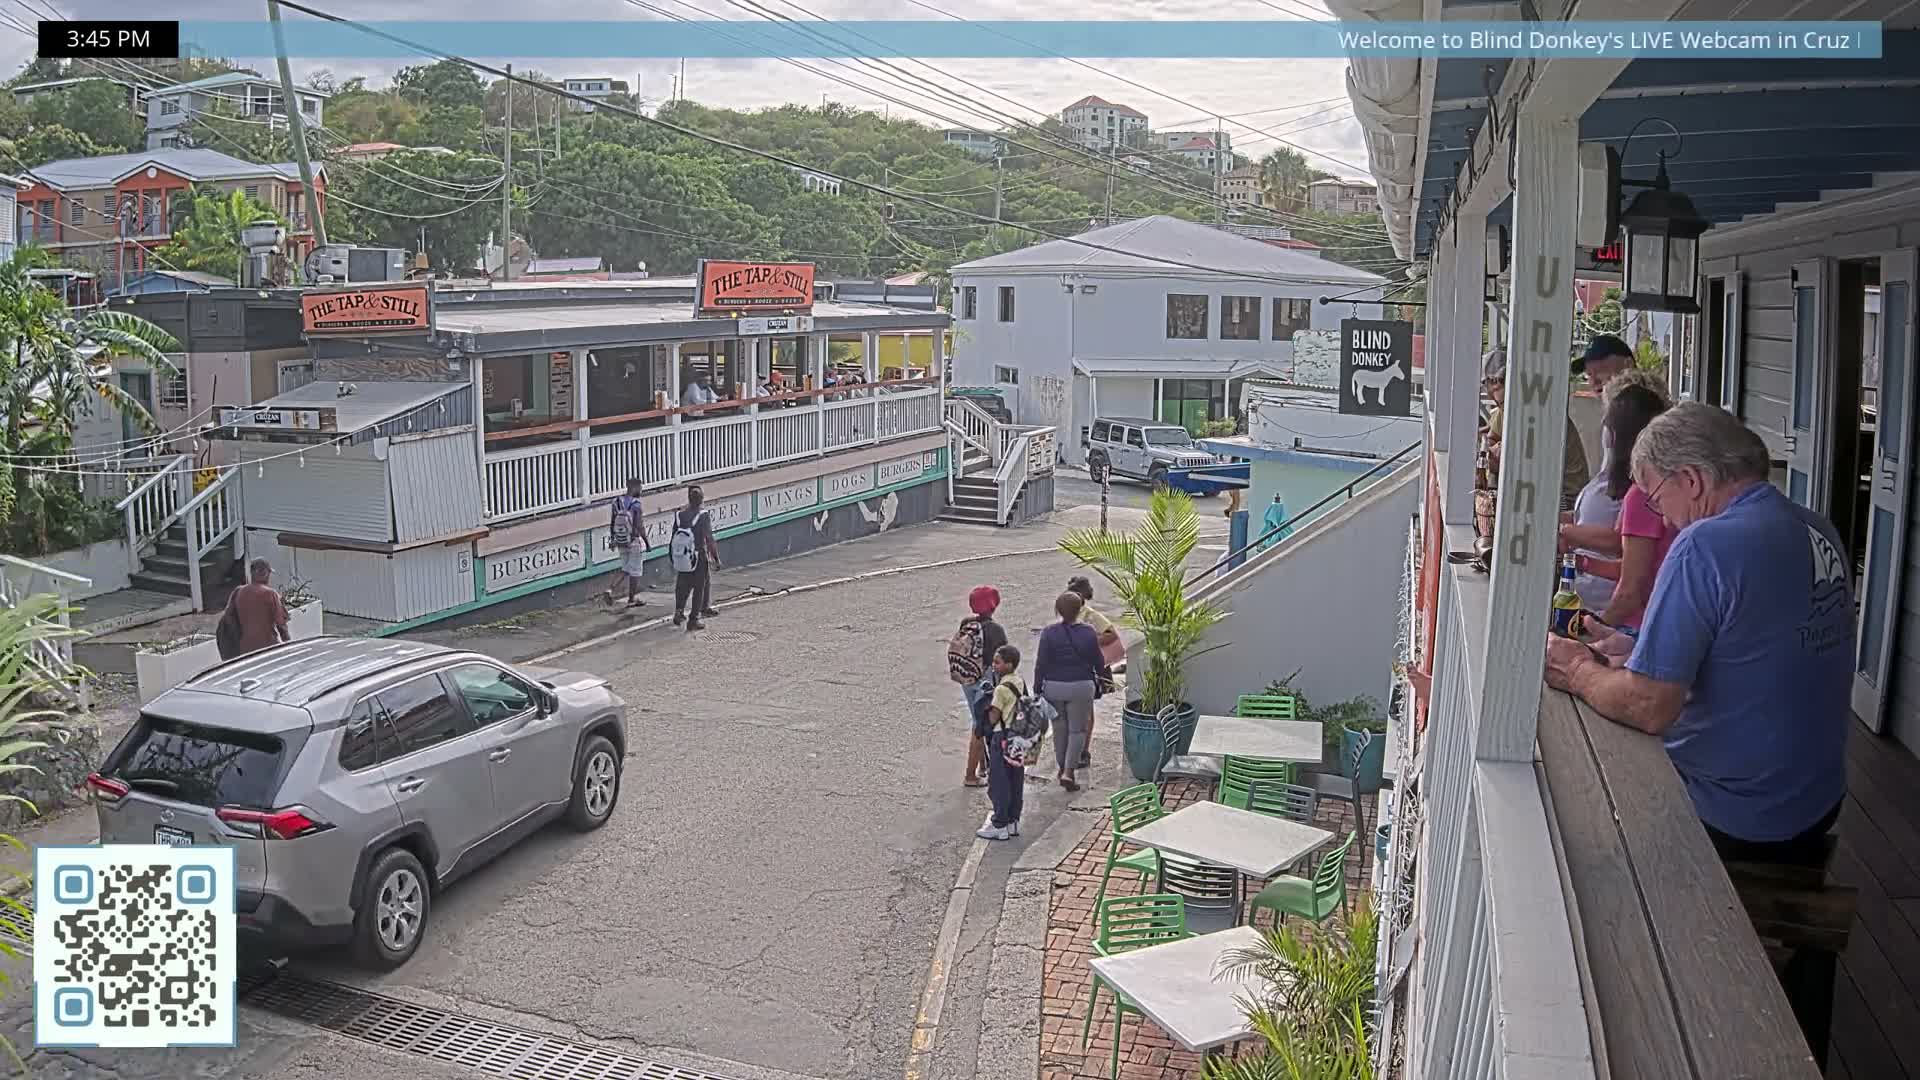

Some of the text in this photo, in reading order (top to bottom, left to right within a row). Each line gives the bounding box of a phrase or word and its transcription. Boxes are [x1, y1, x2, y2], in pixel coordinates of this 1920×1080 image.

[712, 270, 743, 296] THE
[744, 267, 771, 285] TAP
[783, 270, 809, 296] STILL
[308, 300, 336, 321] THE
[335, 295, 365, 312] TAP
[380, 295, 421, 318] STILL
[1352, 330, 1391, 350] BLIND
[1352, 351, 1392, 367] DONKEY
[255, 412, 280, 421] CRUZAN
[1509, 255, 1560, 567] Unwind
[881, 458, 921, 479] BURGERS
[832, 473, 866, 492] DOGS
[764, 486, 813, 509] WINGS
[492, 543, 580, 581] BURGERS
